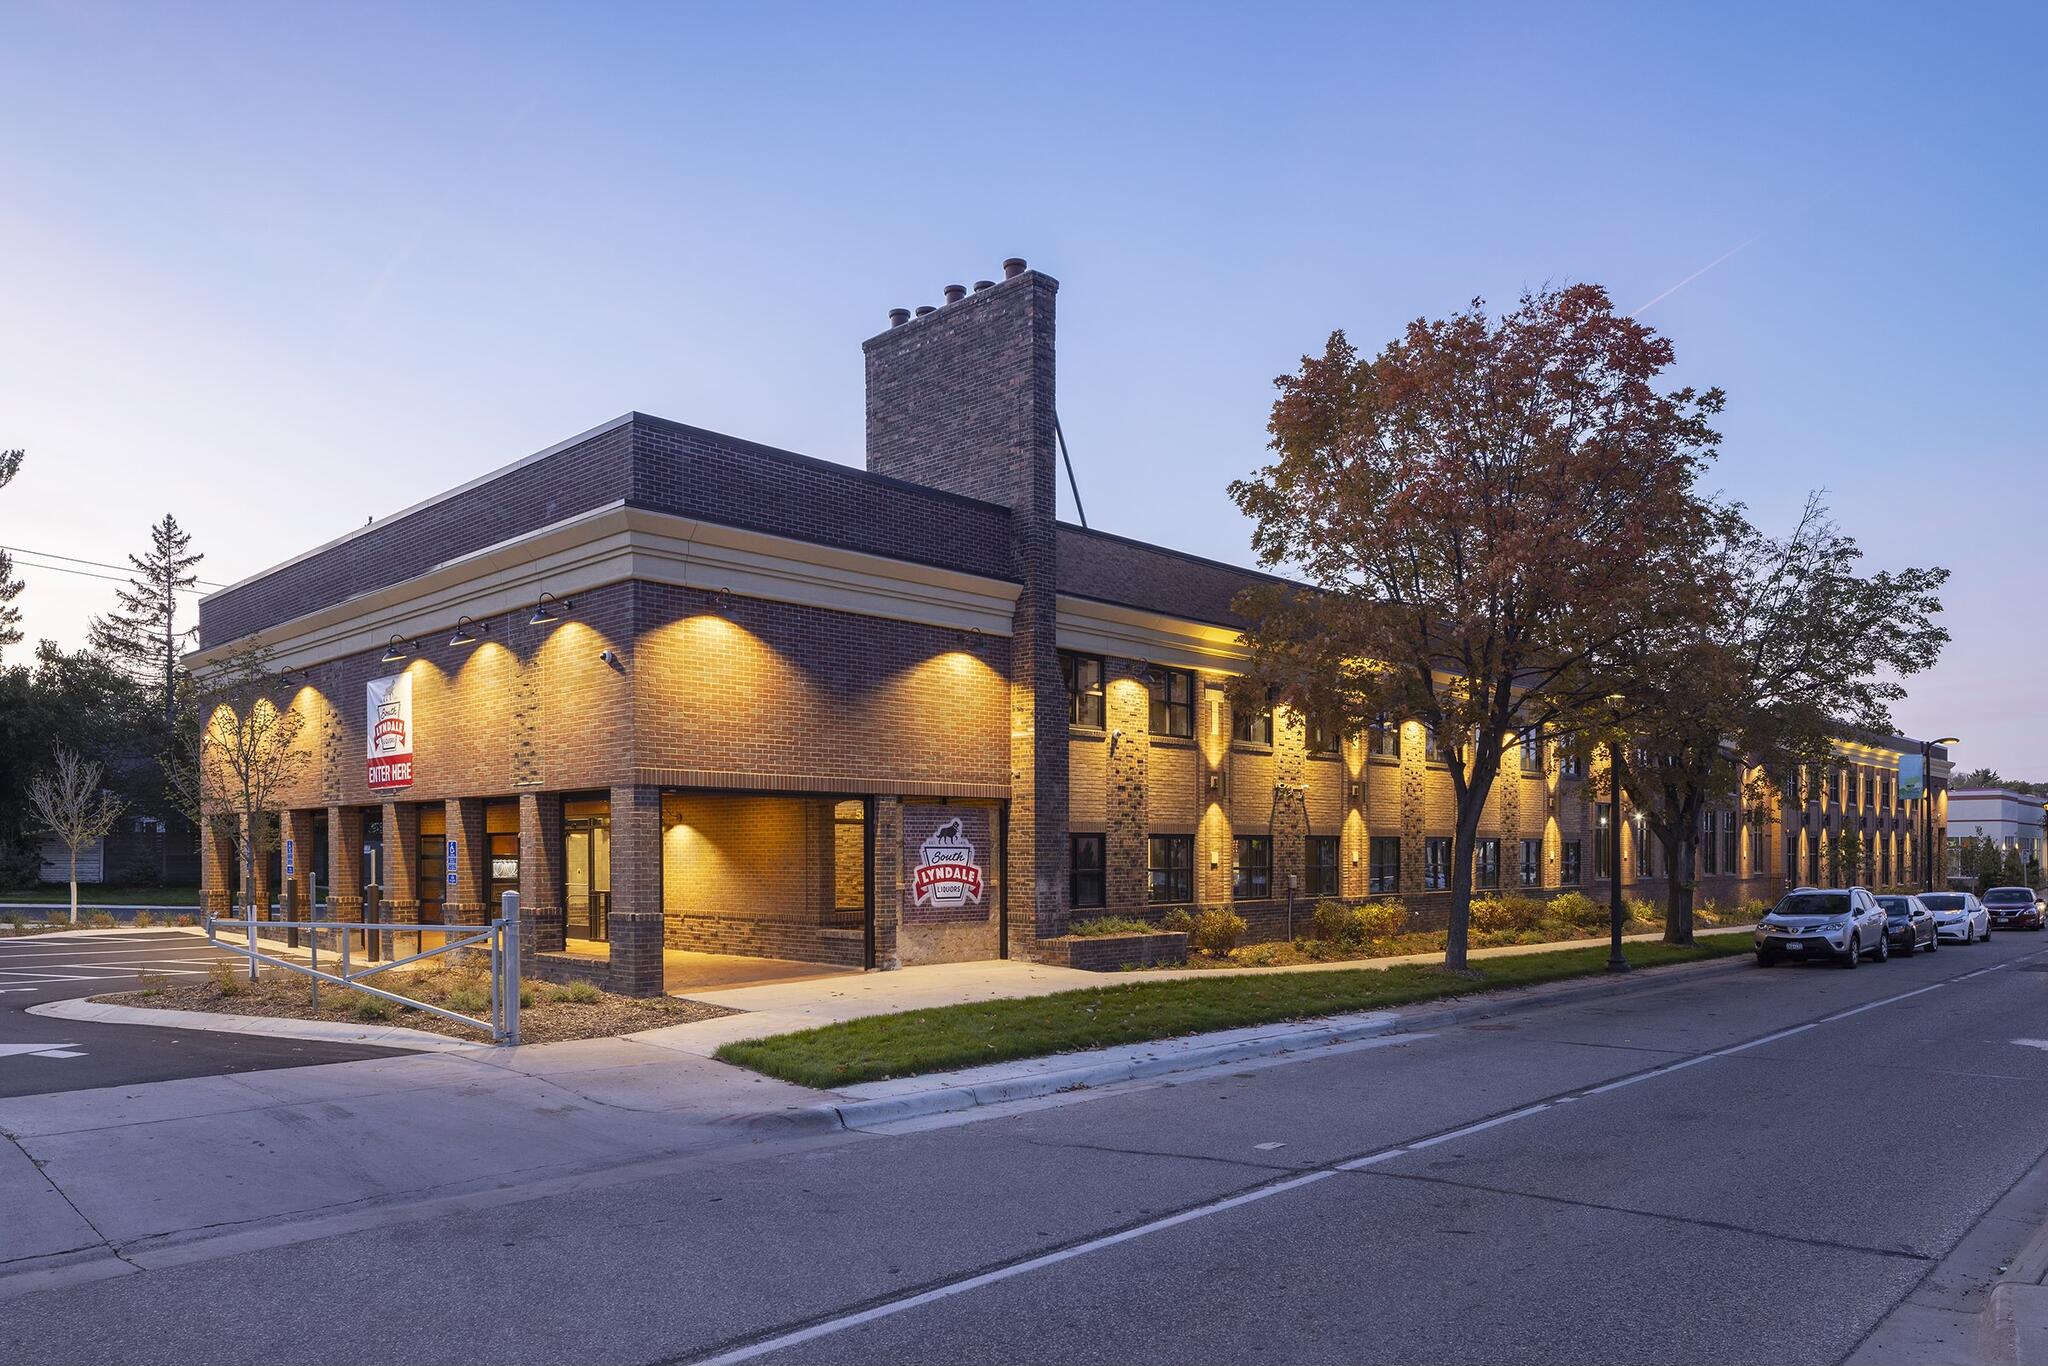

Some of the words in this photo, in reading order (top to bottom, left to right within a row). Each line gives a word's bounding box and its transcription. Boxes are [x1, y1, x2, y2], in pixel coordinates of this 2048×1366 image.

[376, 720, 403, 736] LYNDALE
[369, 765, 390, 783] ENTER
[392, 762, 411, 780] HERE
[932, 851, 965, 863] South
[921, 867, 975, 883] LYNDALE
